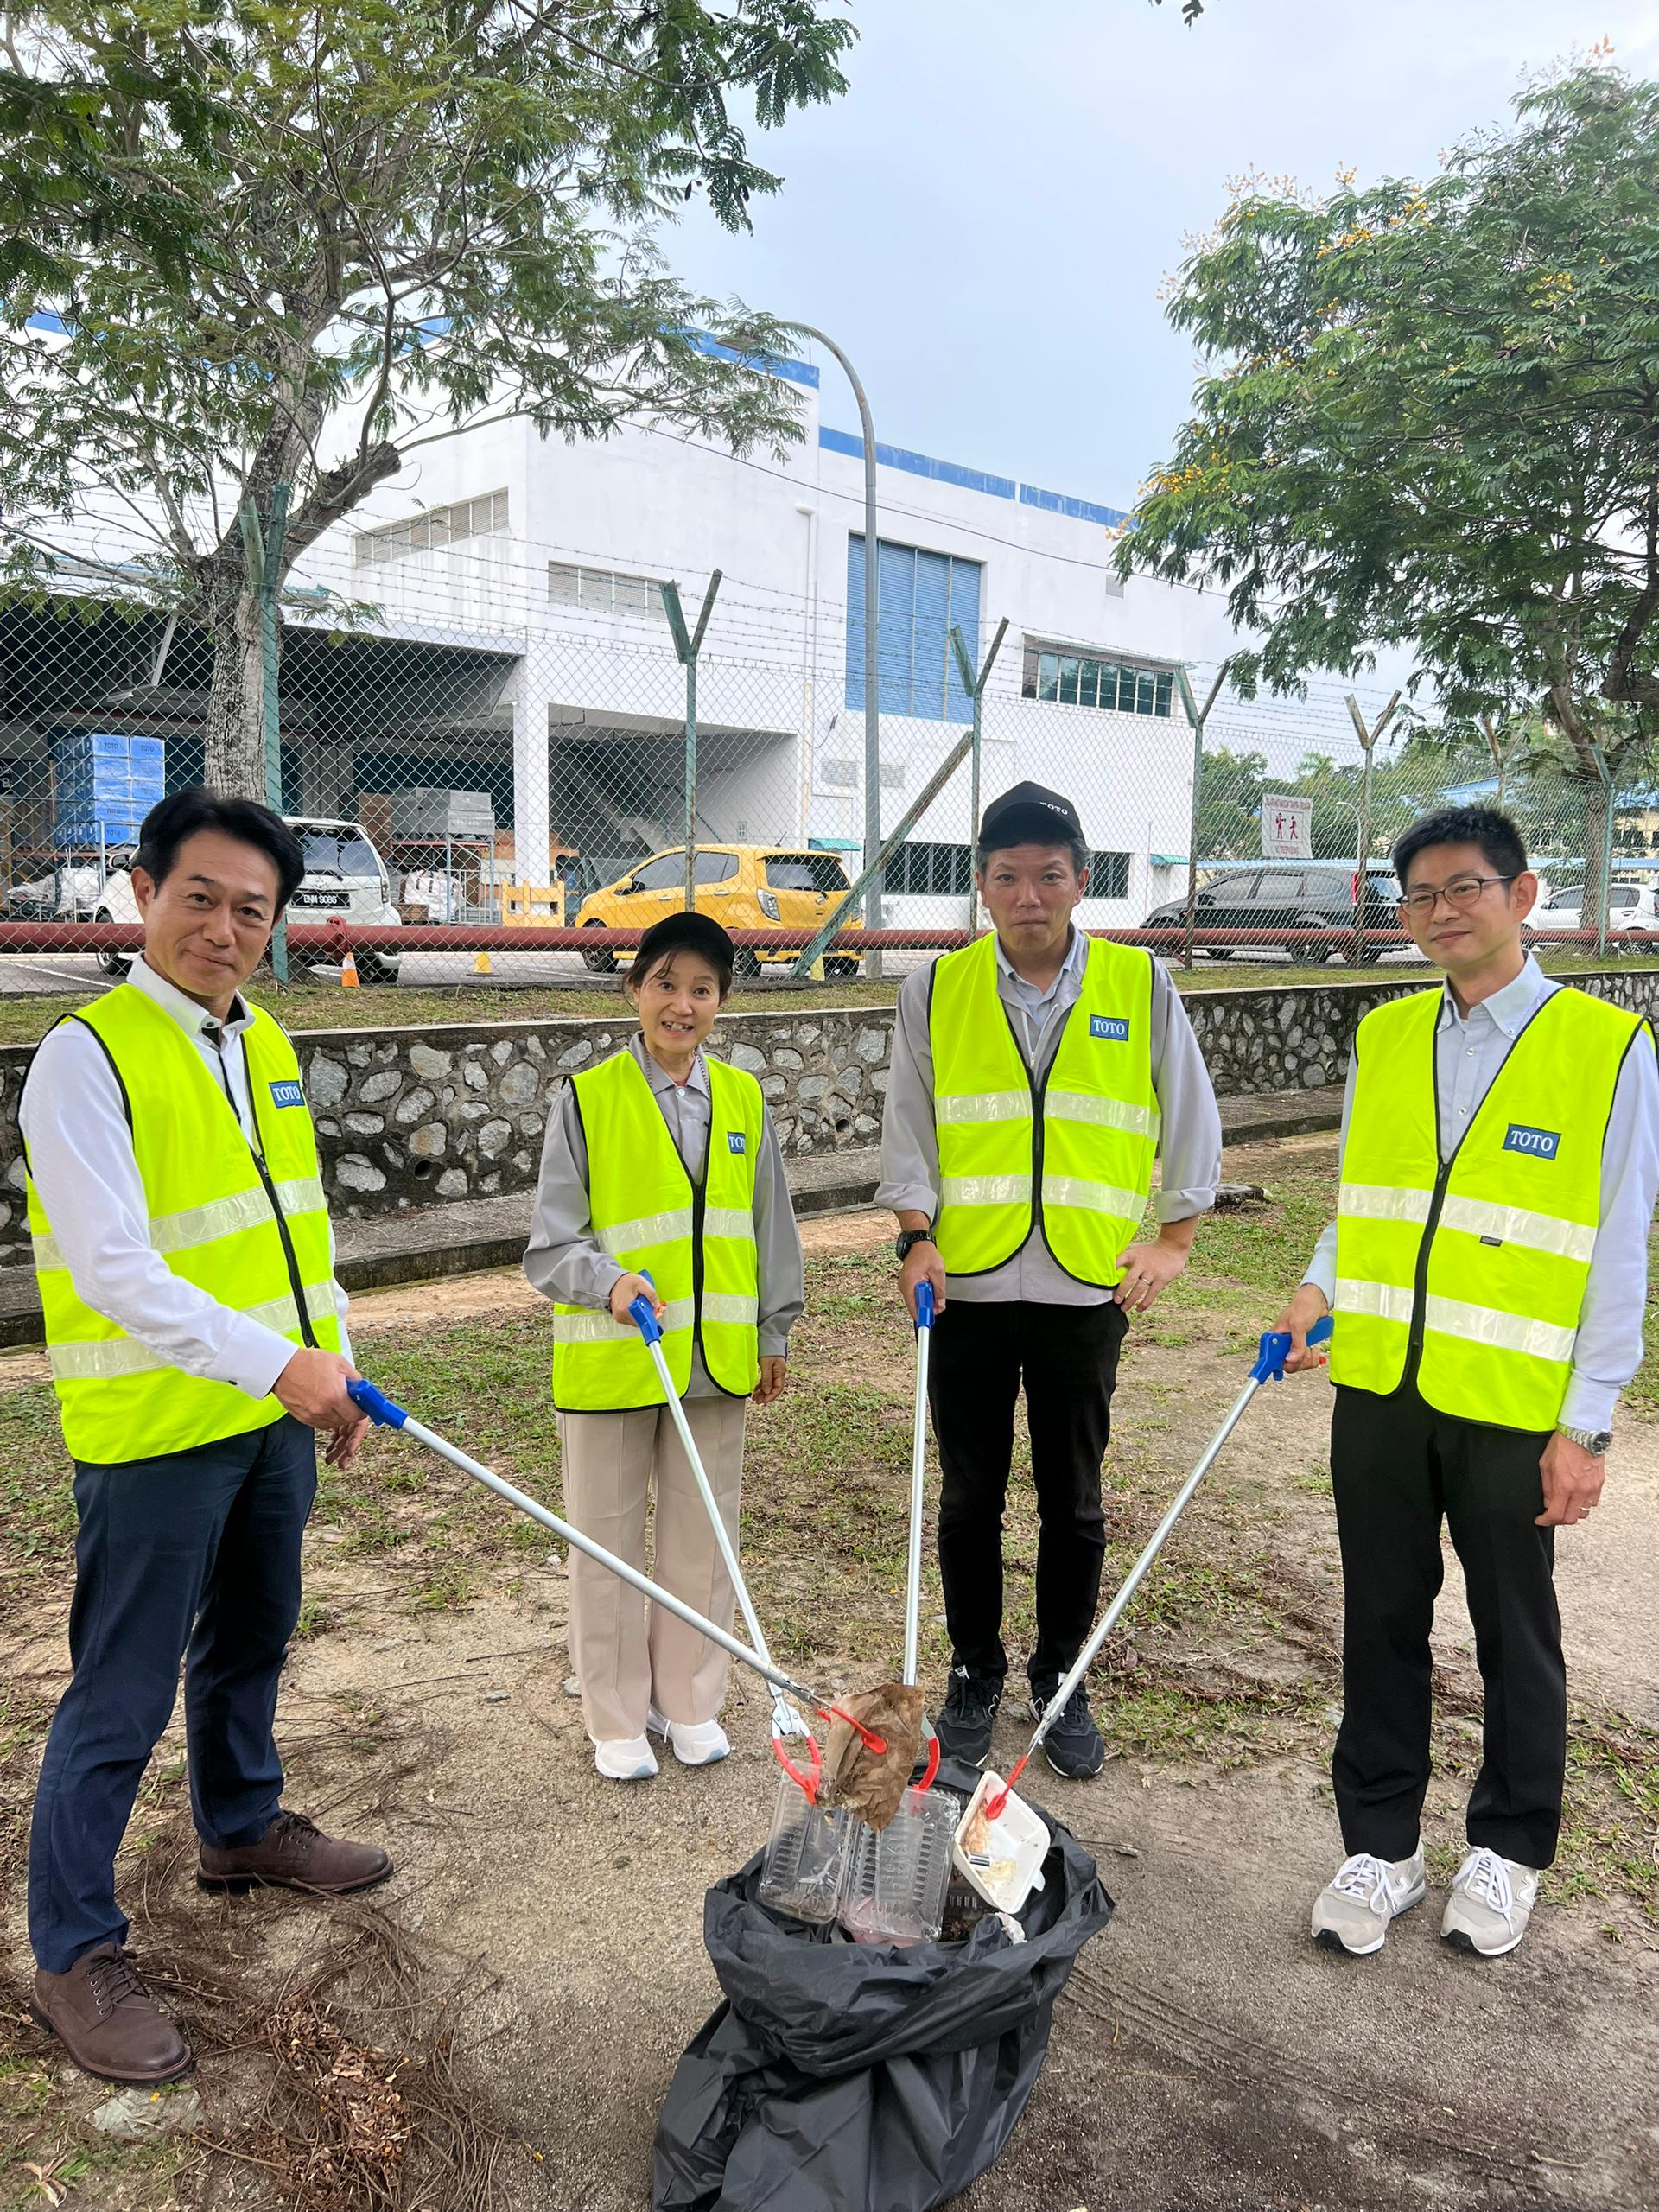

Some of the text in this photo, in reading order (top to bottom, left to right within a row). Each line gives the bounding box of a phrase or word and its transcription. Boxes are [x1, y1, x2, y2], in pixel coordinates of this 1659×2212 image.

[1093, 1020, 1125, 1035] TOTO
[272, 1085, 301, 1102] TOTO
[1510, 1130, 1554, 1152] TOTO
